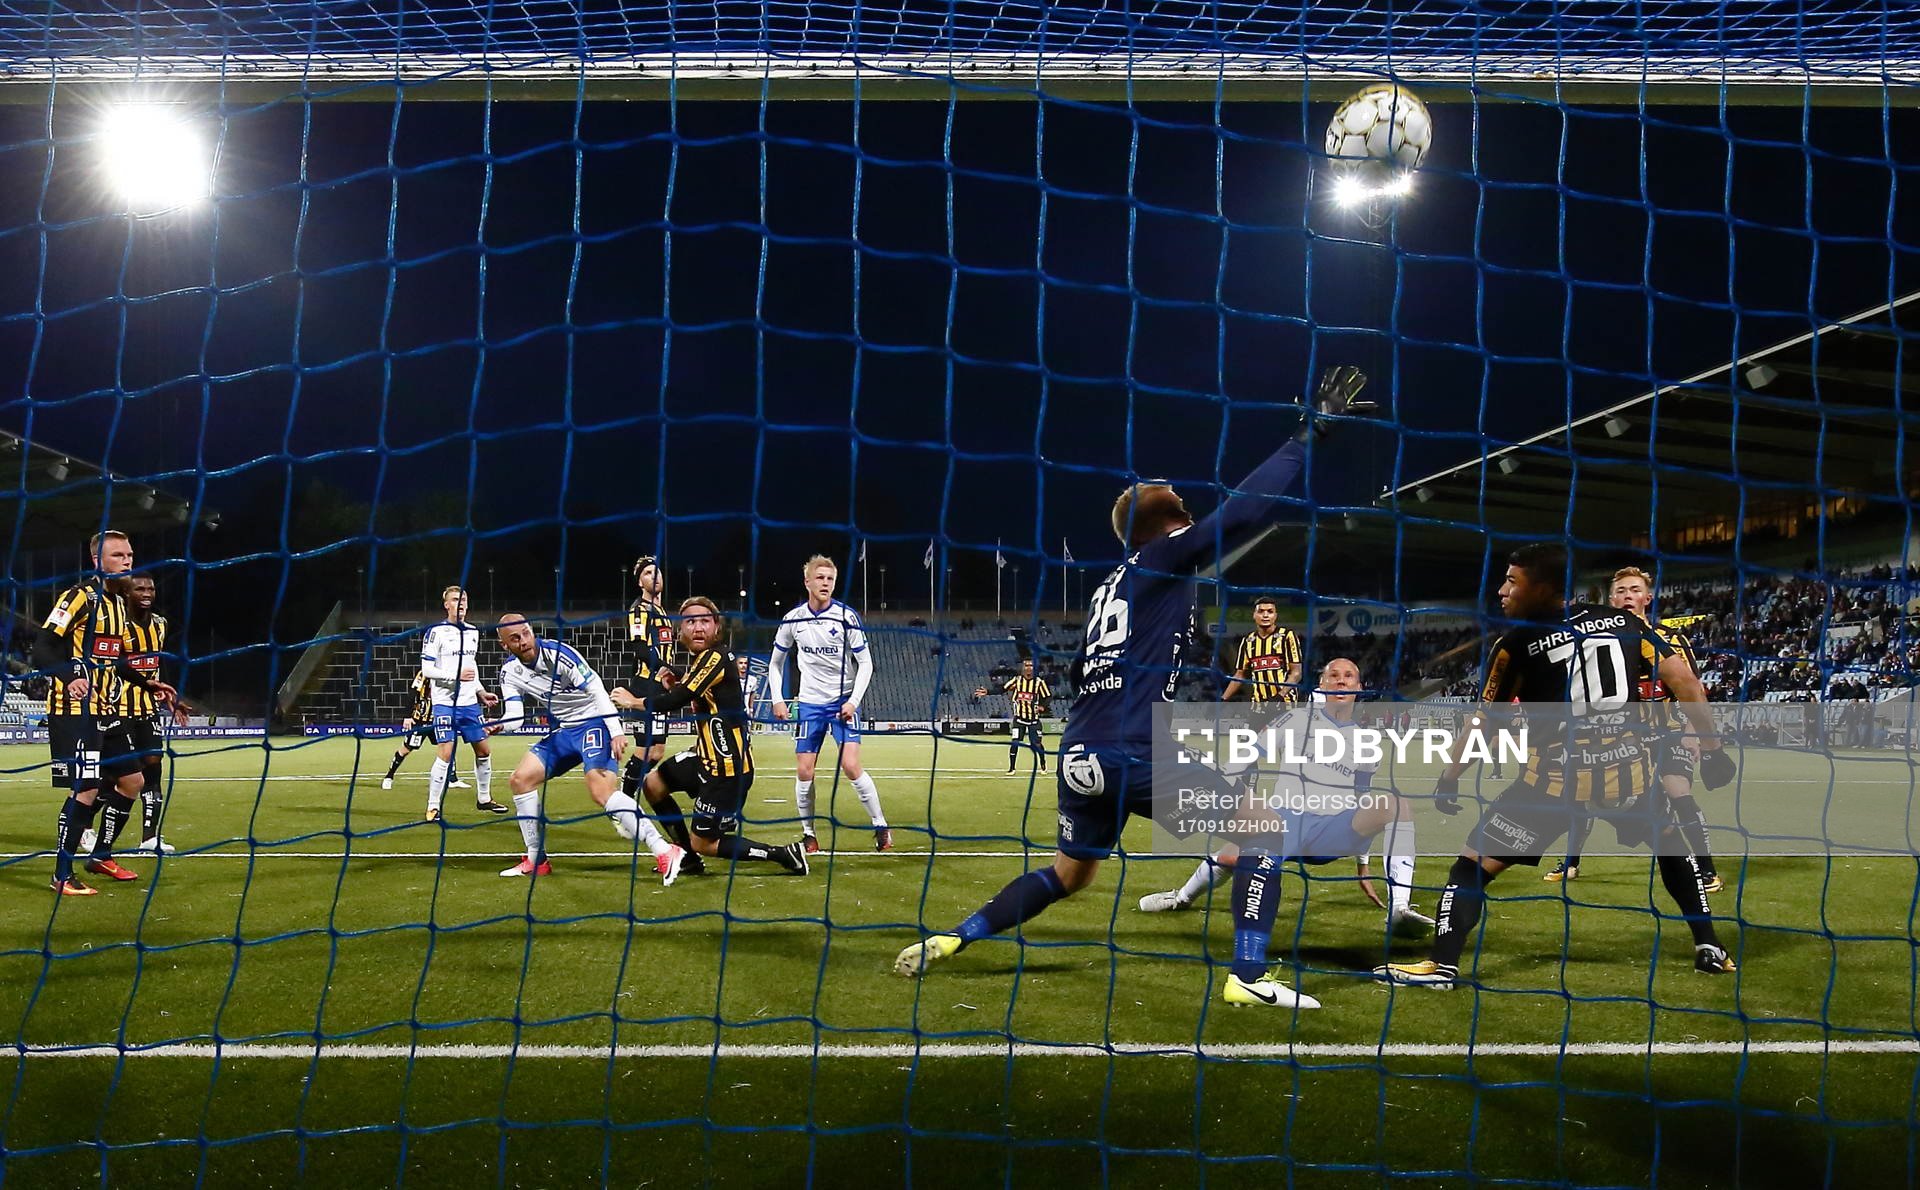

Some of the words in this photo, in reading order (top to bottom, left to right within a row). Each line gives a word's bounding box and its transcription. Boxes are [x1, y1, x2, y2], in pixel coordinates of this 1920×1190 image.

[98, 641, 120, 651] BR
[1244, 879, 1265, 920] BETONG
[1696, 878, 1710, 913] BETONG
